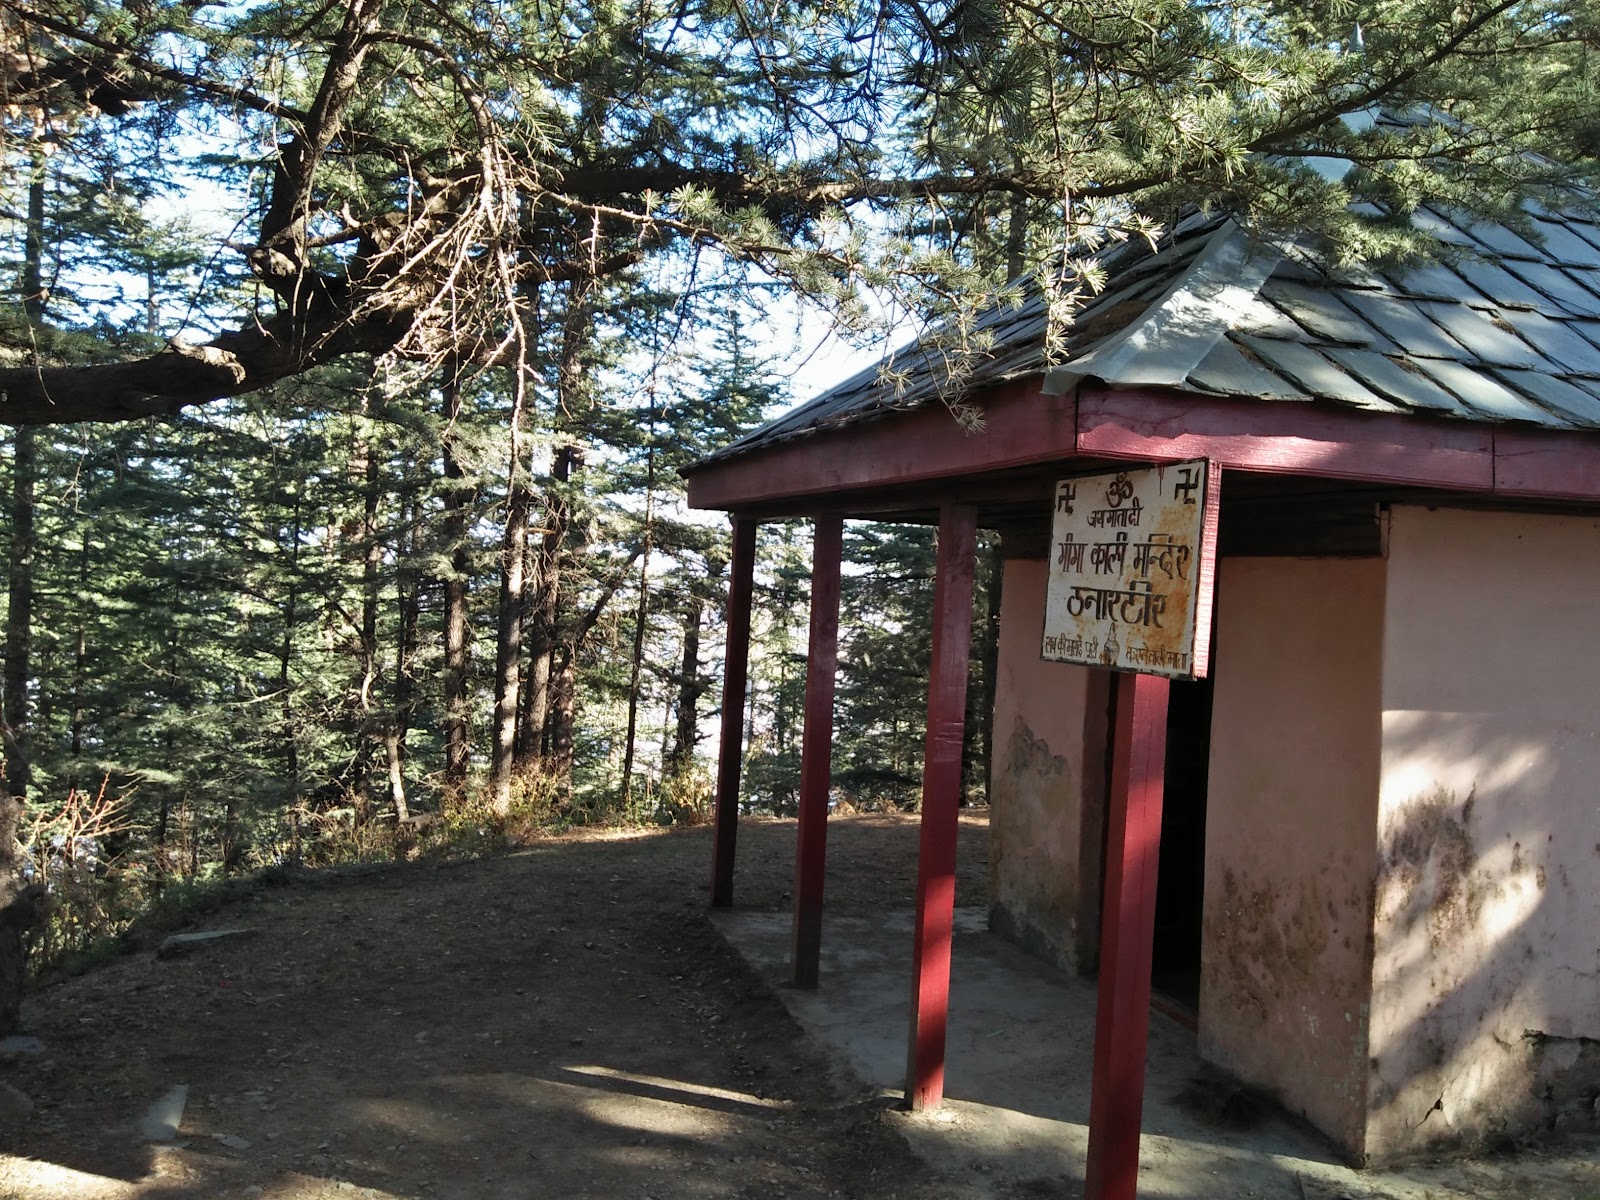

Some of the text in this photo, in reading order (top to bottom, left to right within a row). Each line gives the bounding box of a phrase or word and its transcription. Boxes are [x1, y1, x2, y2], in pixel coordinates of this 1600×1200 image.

[1087, 496, 1144, 528] जय माता दी
[1058, 532, 1192, 580] भीमा काली मन्दिर
